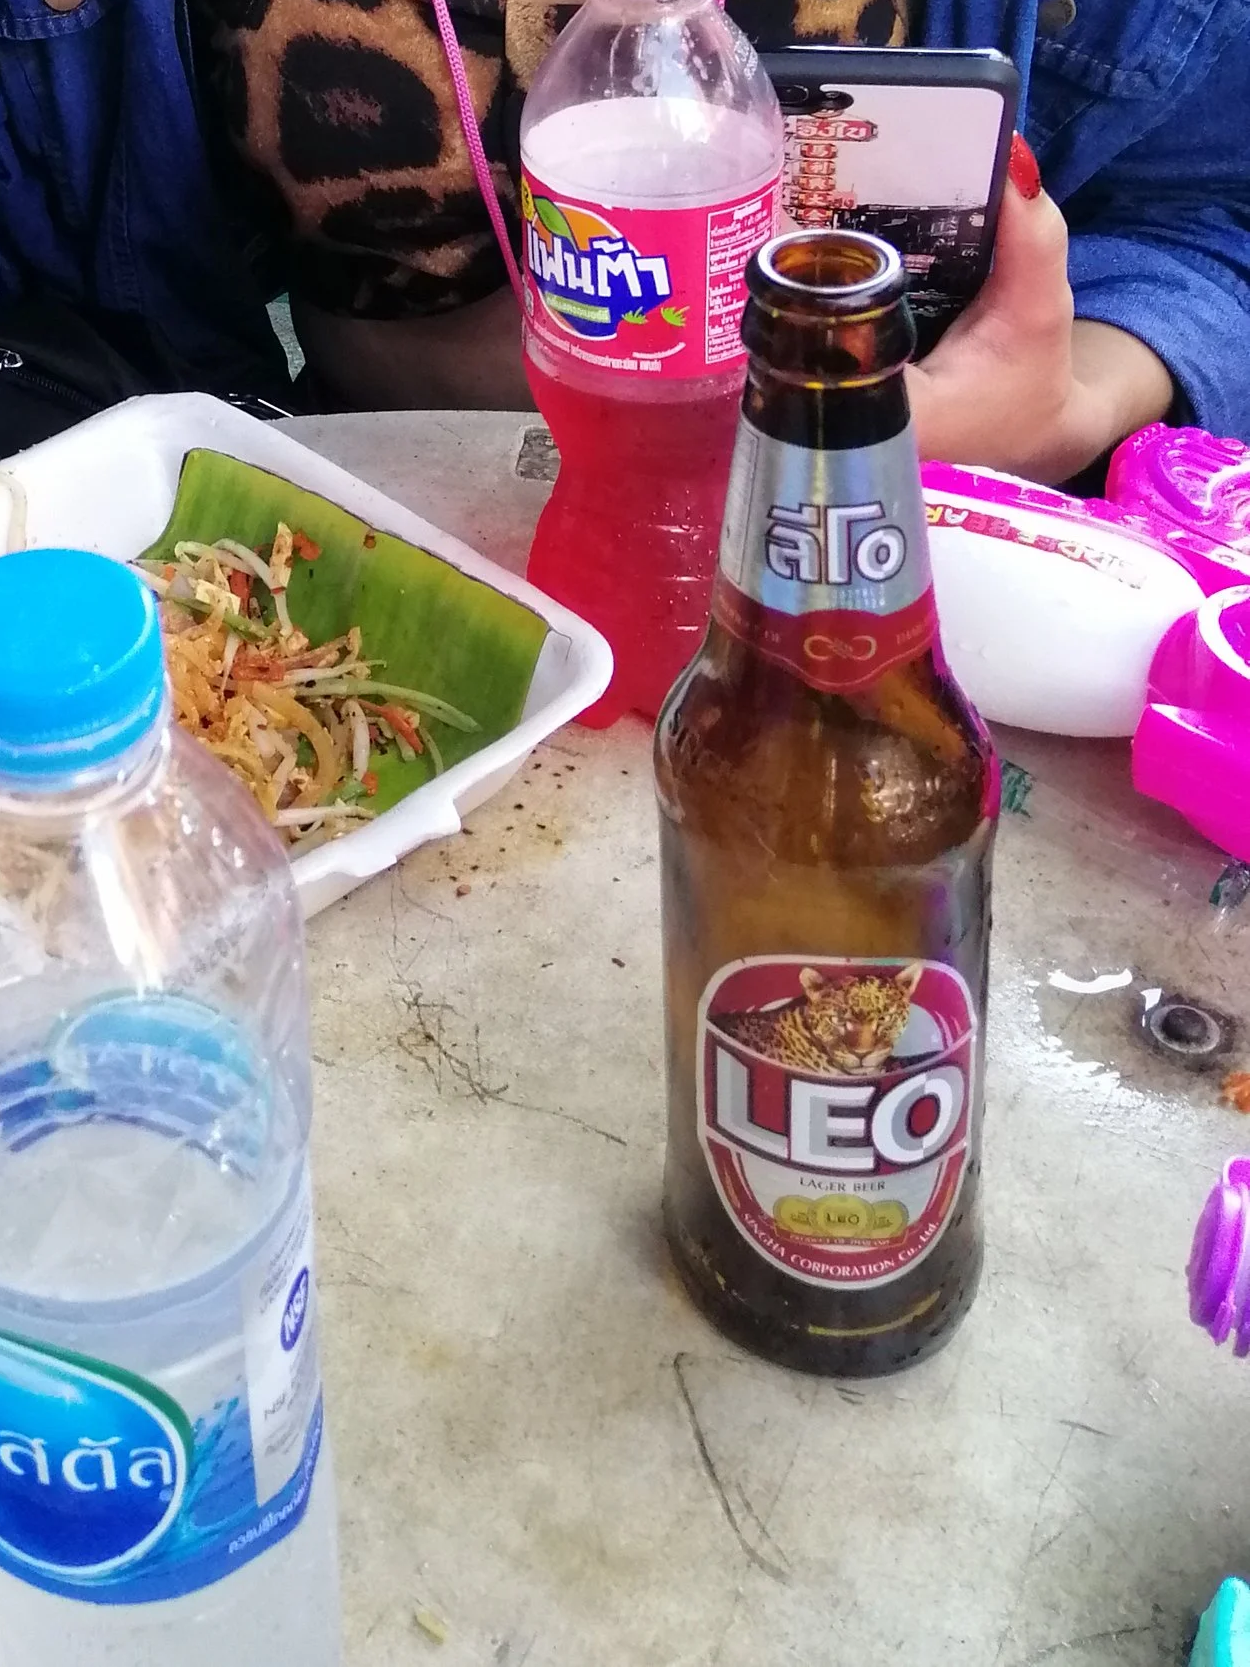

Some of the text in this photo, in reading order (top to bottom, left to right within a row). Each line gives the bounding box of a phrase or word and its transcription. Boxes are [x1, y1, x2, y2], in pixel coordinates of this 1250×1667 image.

[527, 221, 671, 297] แฟนต้า
[766, 500, 907, 584] ลีโอ
[715, 1044, 965, 1170] LEO
[799, 1176, 886, 1192] LAGER BEER
[744, 1213, 786, 1258] SINGHA
[790, 1253, 896, 1277] CORPORATION
